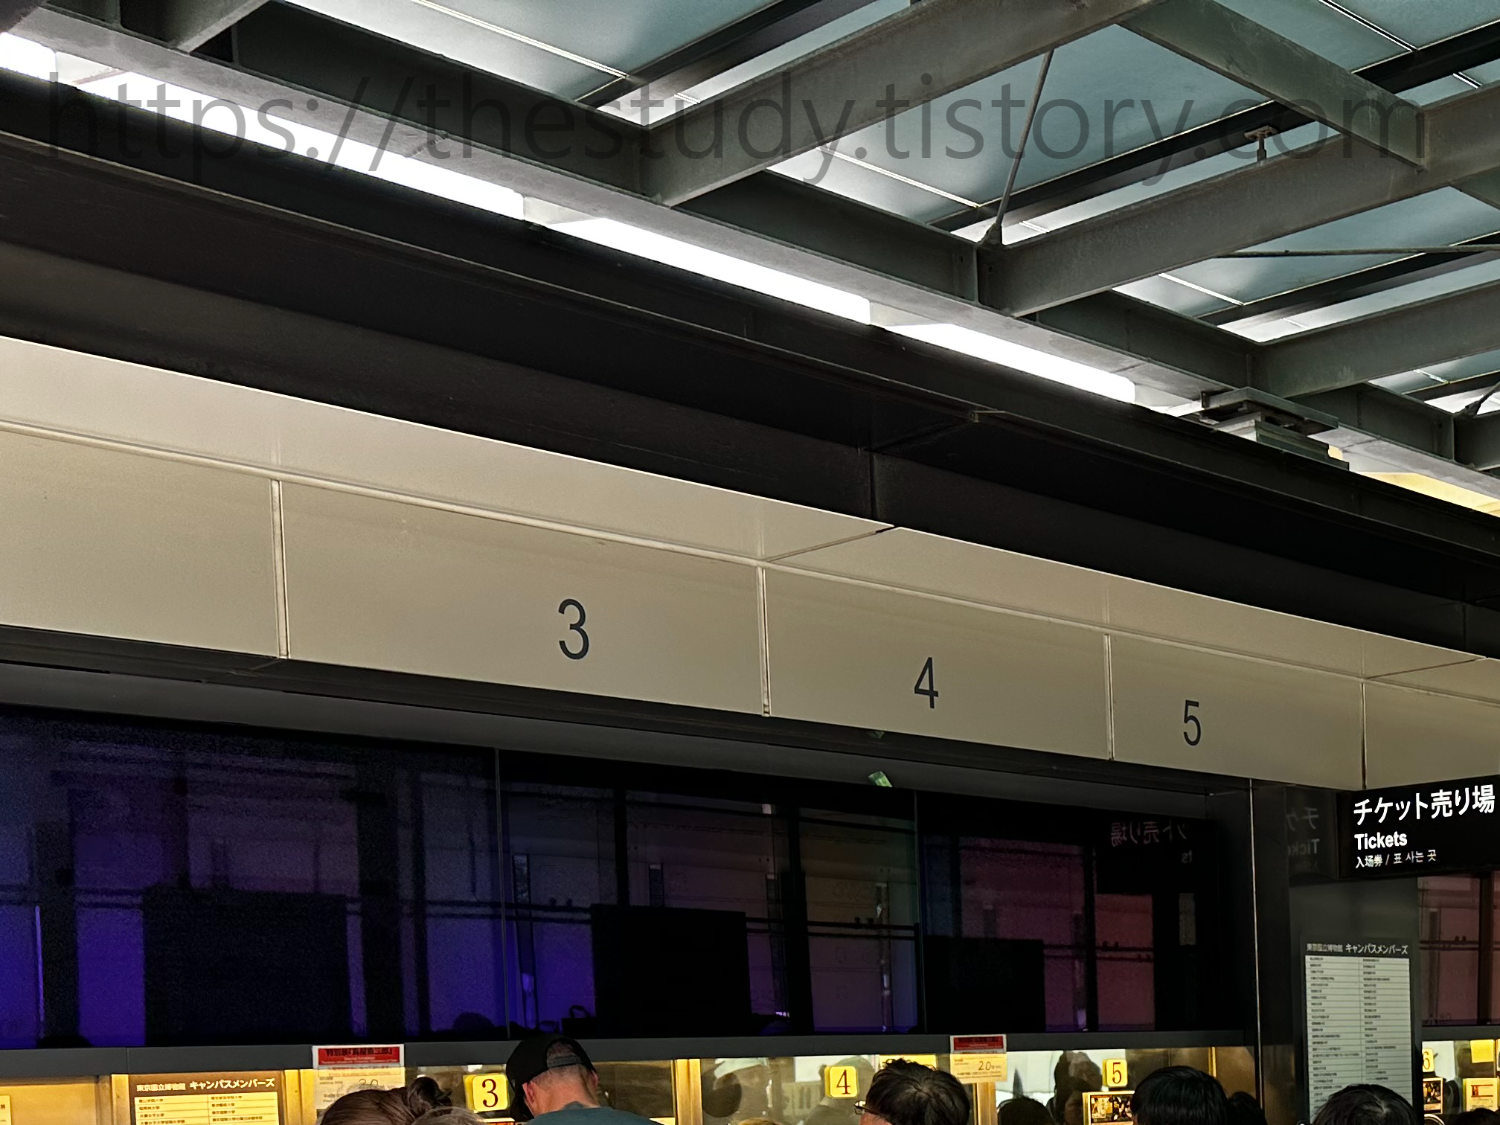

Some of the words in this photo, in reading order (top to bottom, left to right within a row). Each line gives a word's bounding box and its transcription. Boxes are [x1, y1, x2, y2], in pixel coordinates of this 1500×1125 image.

[558, 598, 590, 660] 3
[913, 656, 939, 709] 4
[1182, 699, 1202, 747] 5
[1353, 783, 1496, 826] チケット売り場
[1353, 830, 1408, 851] Tickets
[1393, 852, 1403, 865] 표
[1405, 850, 1425, 864] 사는
[1427, 849, 1437, 862] 곳
[1112, 1061, 1122, 1085] 5
[1422, 1050, 1431, 1071] 6
[189, 1077, 276, 1090] キャンパスメンバーズ
[481, 1078, 499, 1108] 3
[835, 1068, 852, 1095] 4
